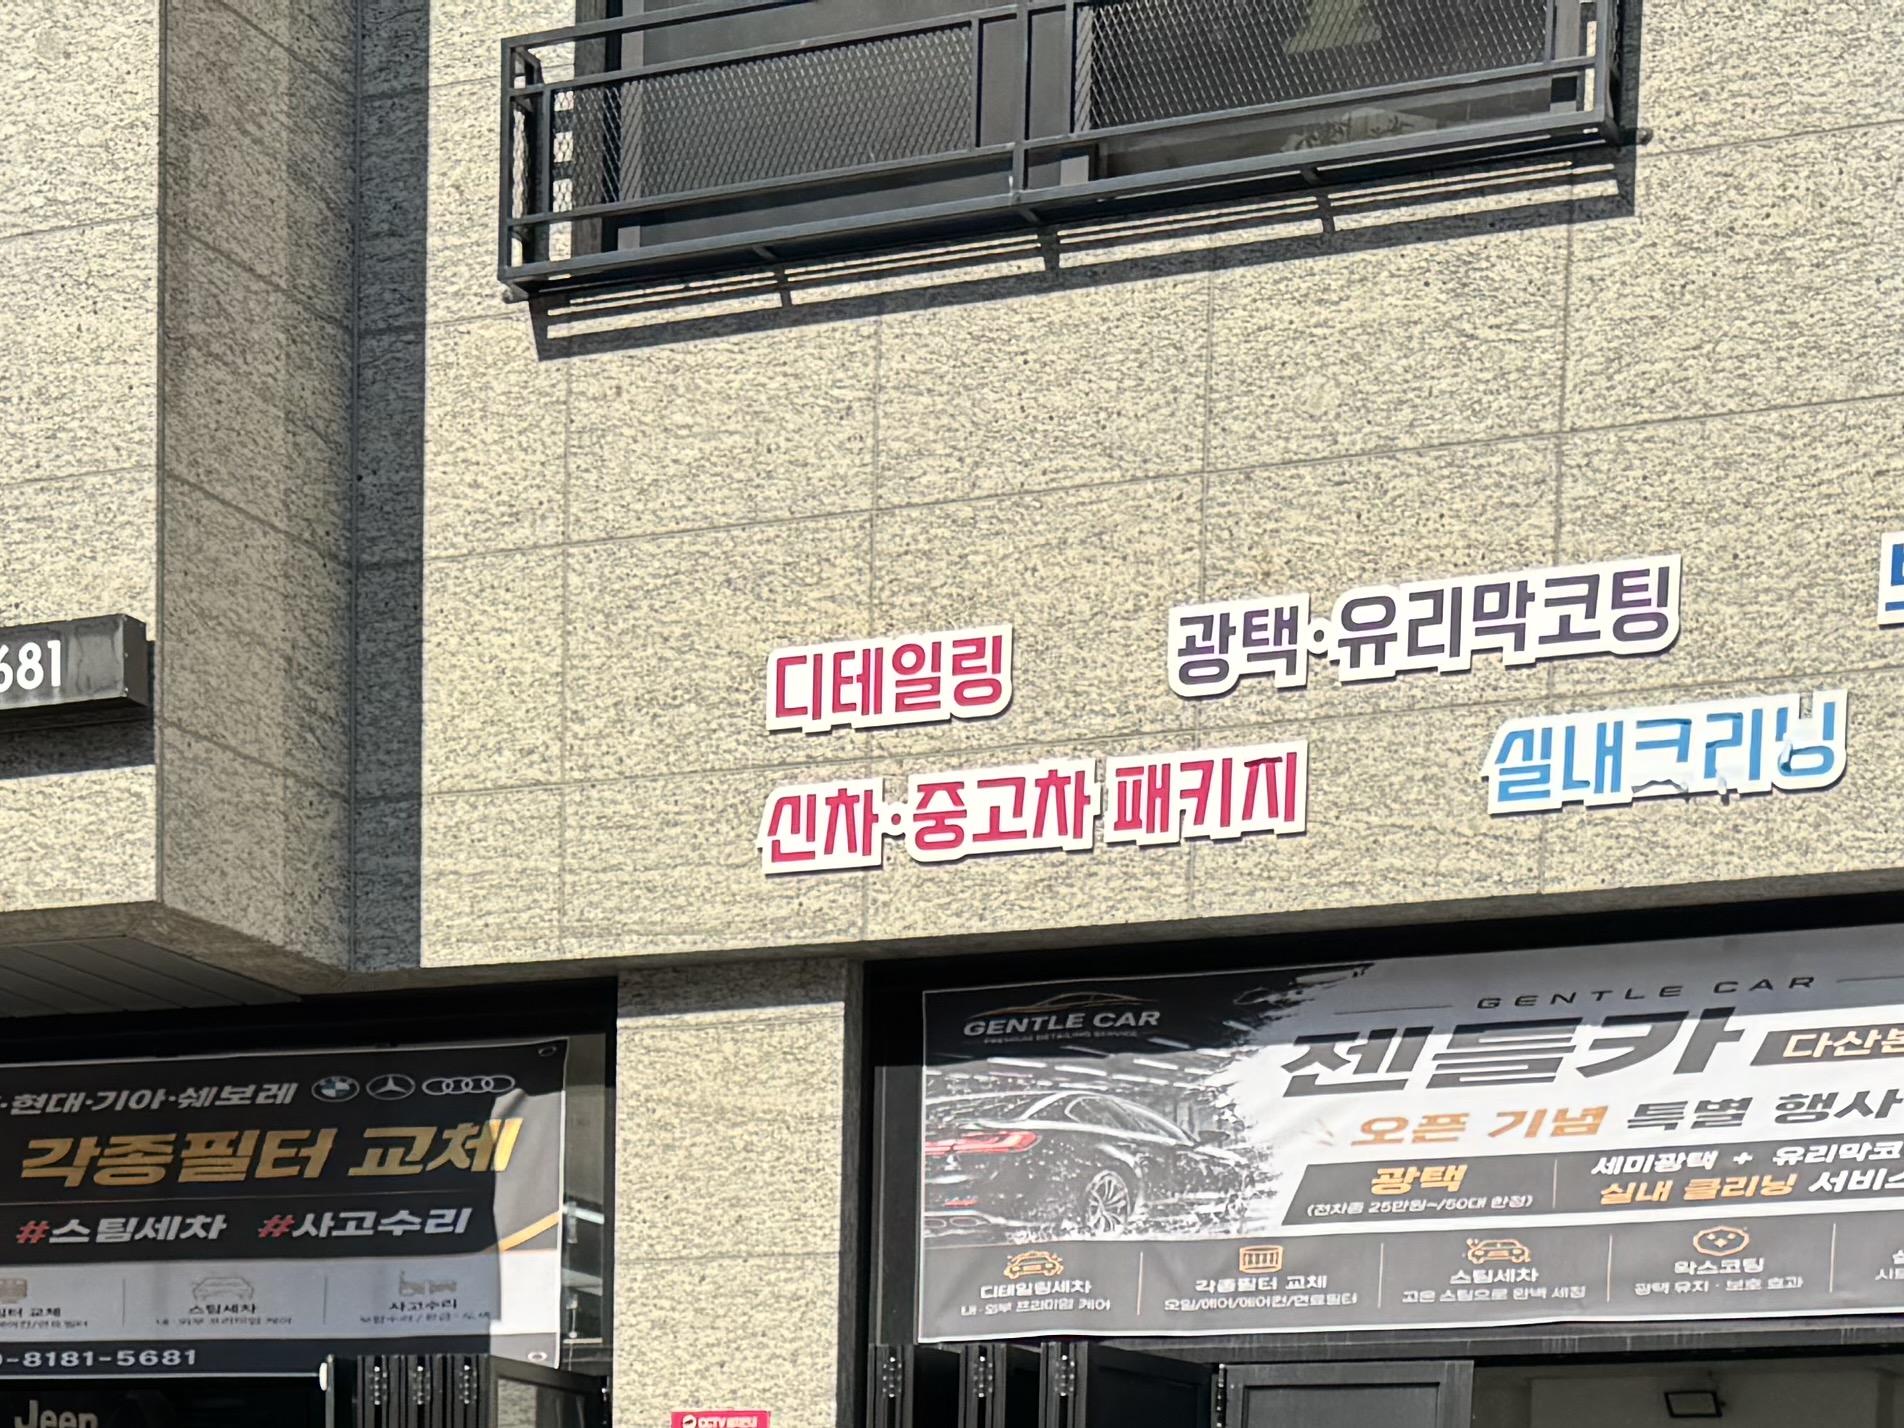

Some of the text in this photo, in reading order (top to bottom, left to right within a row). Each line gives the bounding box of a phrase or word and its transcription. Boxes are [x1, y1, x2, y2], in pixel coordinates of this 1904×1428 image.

[1177, 564, 1673, 686] 광택·유리막코팅
[773, 630, 1005, 719] 디테일링
[768, 748, 1299, 865] 신차·중고차 패키지
[1476, 974, 1818, 1011] GENTLE CAR
[963, 1010, 1161, 1037] GENTLE CAR
[1280, 1006, 1745, 1098] 젠틀카
[1350, 1110, 1472, 1148] 오픈
[1487, 1104, 1609, 1140] 기념
[1625, 1095, 1753, 1133] 특별
[20, 1128, 338, 1188] 각종필터
[348, 1116, 525, 1178] 교체
[1591, 1149, 1719, 1176] 세미광택
[1371, 1164, 1468, 1196] 광택
[1599, 1179, 1671, 1206] 실내
[1682, 1172, 1798, 1201] 클리닝
[16, 1214, 228, 1245] #스팀세차
[257, 1206, 472, 1239] #사고수리
[1449, 1267, 1540, 1285] 스팀세차
[1674, 1256, 1765, 1275] 왁스코팅
[980, 1278, 1093, 1301] 디테일링세차
[1195, 1274, 1329, 1295] 각종필터 교체
